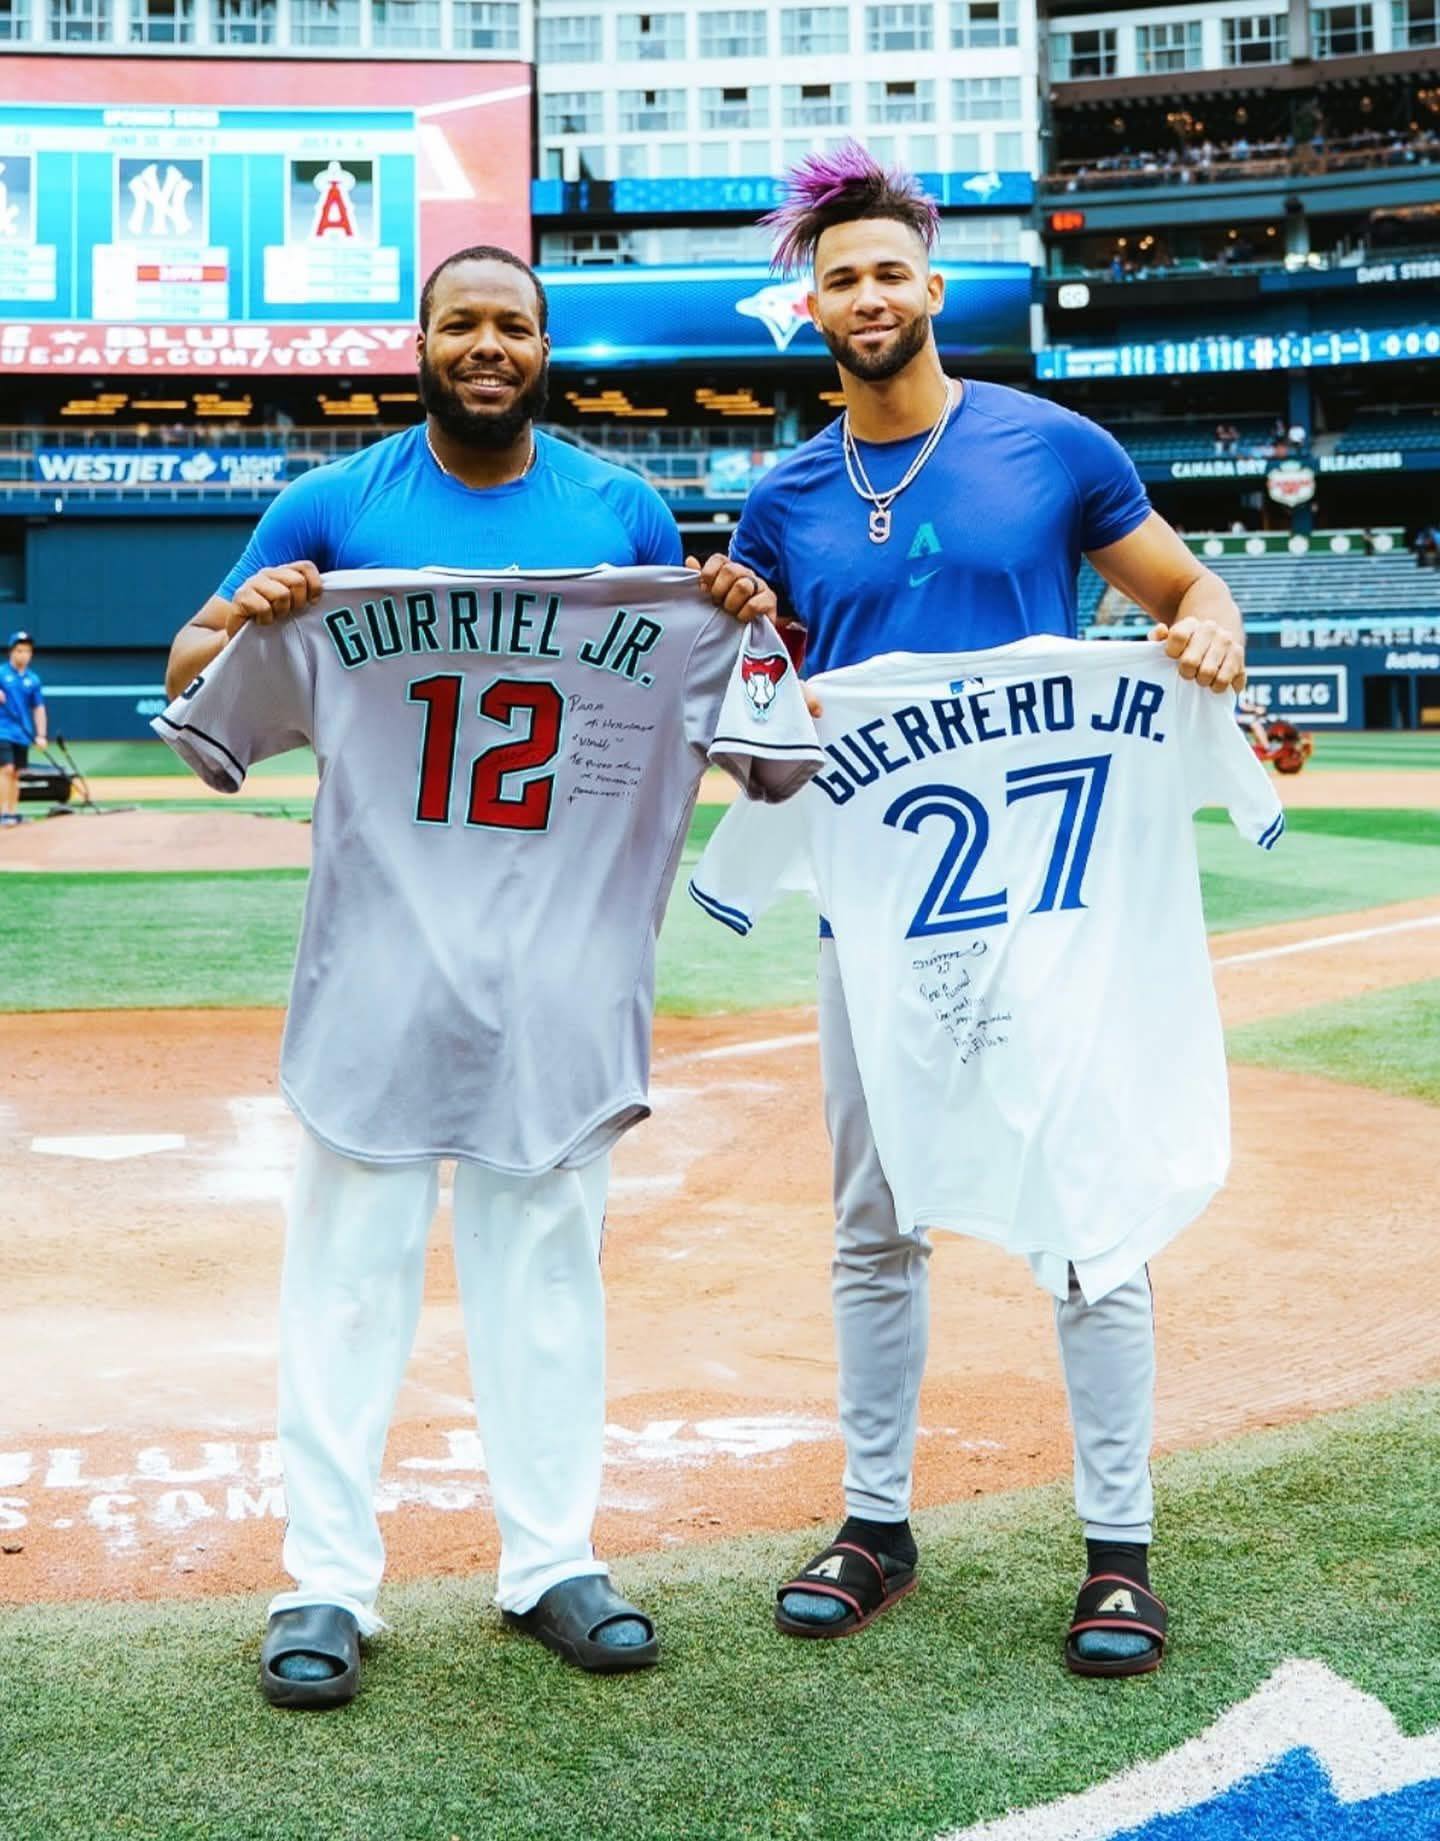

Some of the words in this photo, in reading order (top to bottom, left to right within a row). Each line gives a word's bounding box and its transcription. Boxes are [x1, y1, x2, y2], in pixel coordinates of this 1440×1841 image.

[1357, 264, 1396, 284] DAVE
[106, 327, 269, 348] BLUE
[38, 454, 180, 485] WESTJET
[1171, 461, 1234, 478] CANADA
[1236, 459, 1268, 475] DRY
[1320, 452, 1402, 471] BLEACHERS
[323, 588, 563, 671] GURRIEL
[577, 607, 665, 688] JR.
[1279, 684, 1330, 706] KEG
[406, 673, 566, 834] 12
[811, 675, 1075, 805] GUERRERO
[1090, 676, 1166, 743] JR.
[883, 754, 1112, 939] 27
